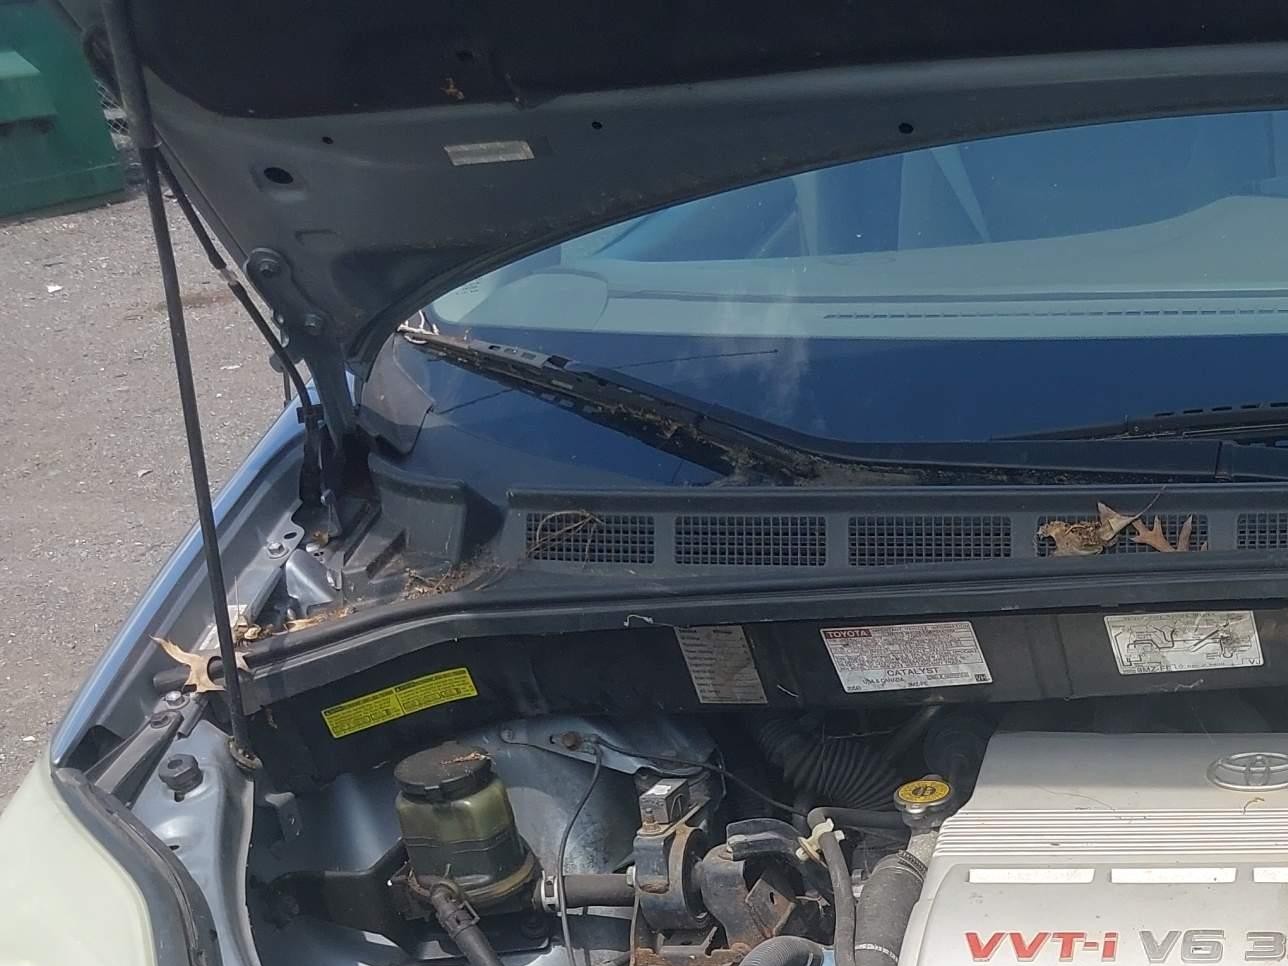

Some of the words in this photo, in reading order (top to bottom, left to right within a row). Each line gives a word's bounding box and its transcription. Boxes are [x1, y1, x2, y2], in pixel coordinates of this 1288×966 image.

[827, 630, 868, 638] TOYOTA
[886, 667, 939, 677] CATALYST
[965, 931, 1119, 963] VVT-i
[1138, 929, 1226, 964] V6
